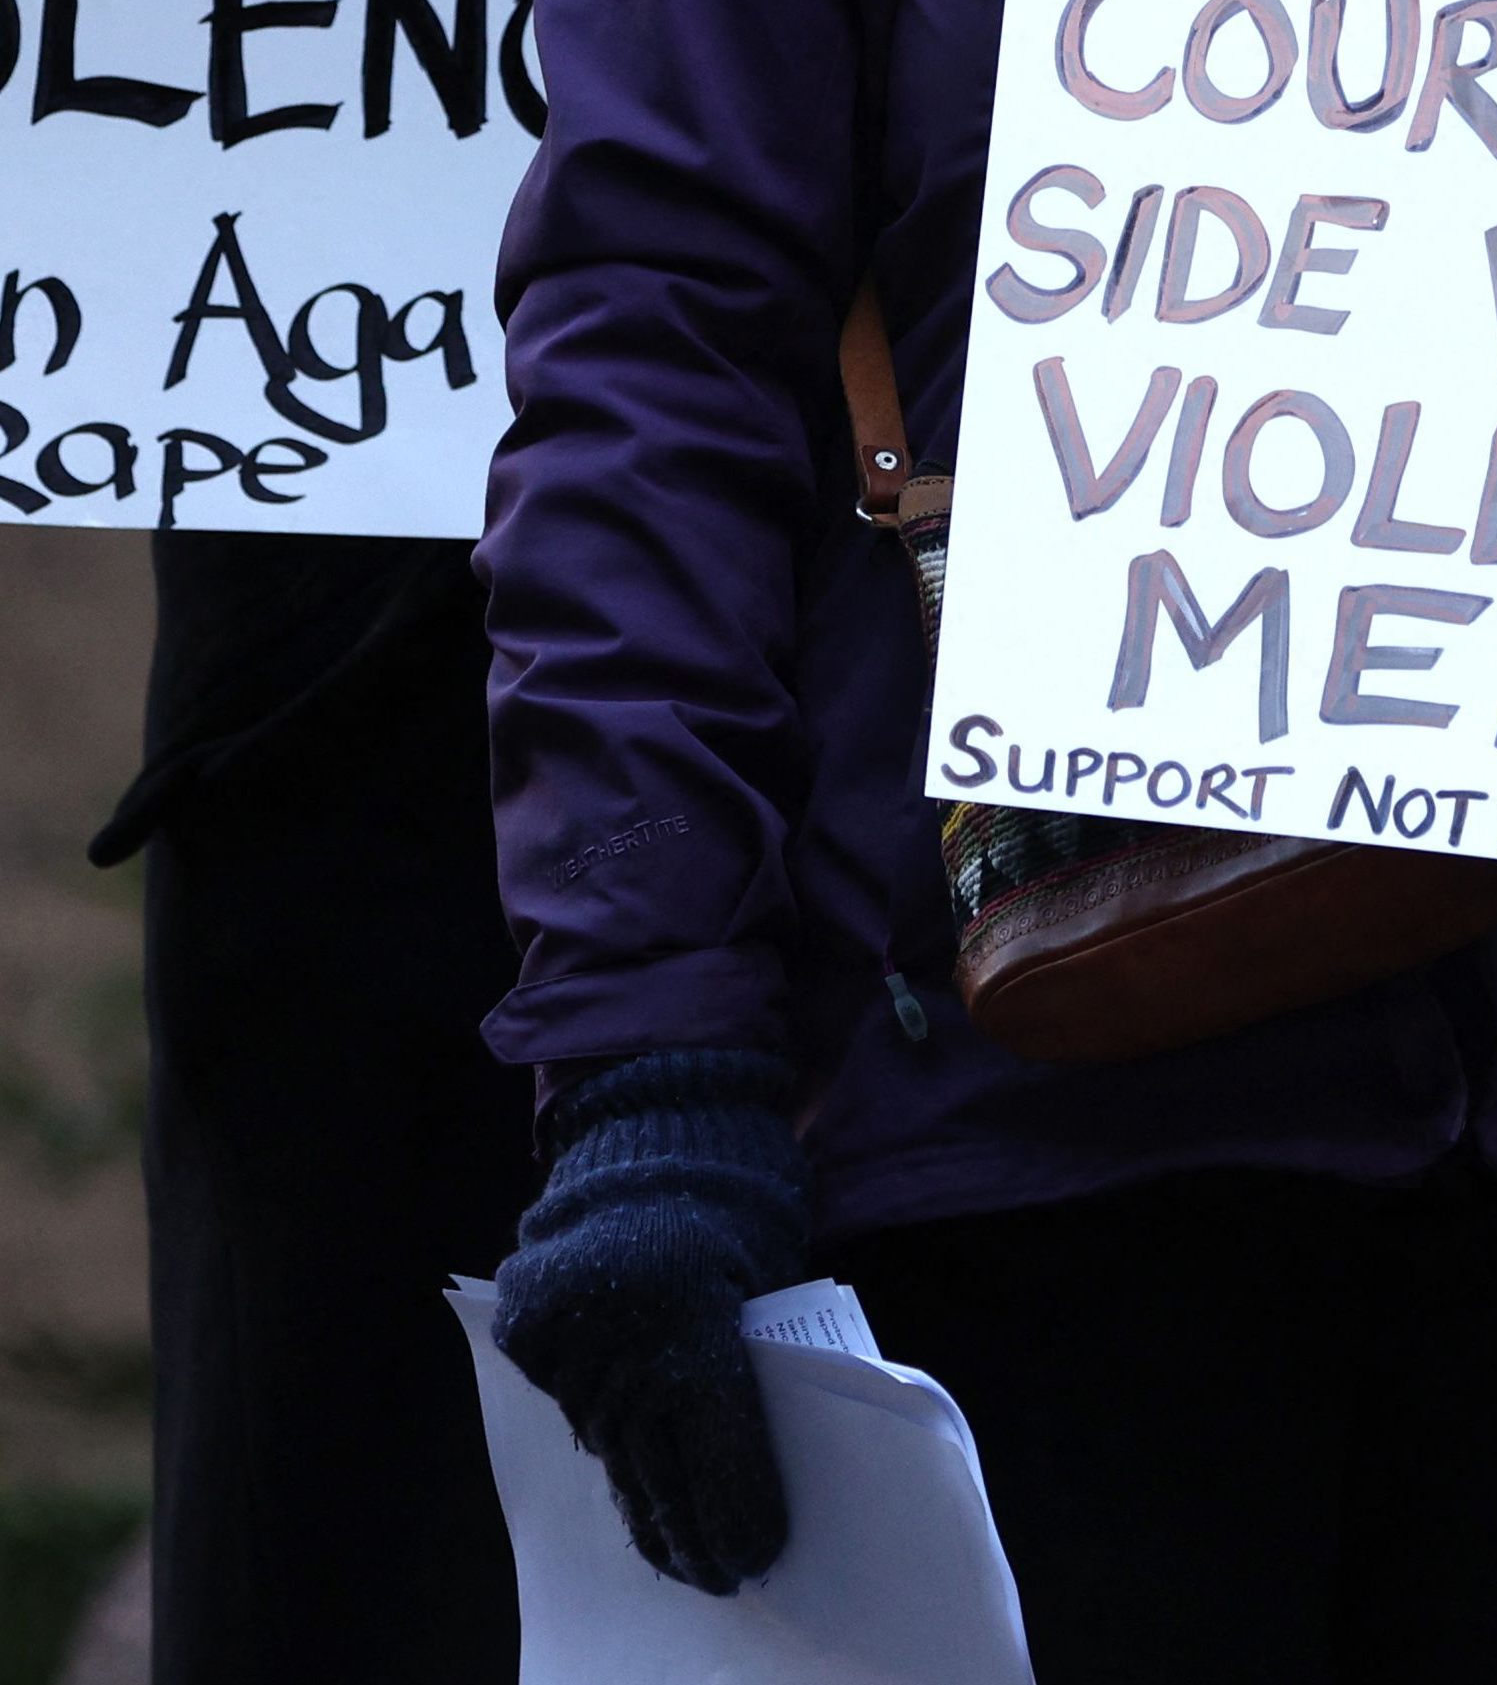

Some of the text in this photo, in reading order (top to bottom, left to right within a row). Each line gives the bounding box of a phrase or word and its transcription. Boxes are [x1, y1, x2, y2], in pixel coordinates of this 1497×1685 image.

[984, 163, 1391, 336] SIDE
[940, 713, 1296, 823] SUPPORT
[1325, 765, 1490, 849] NOT
